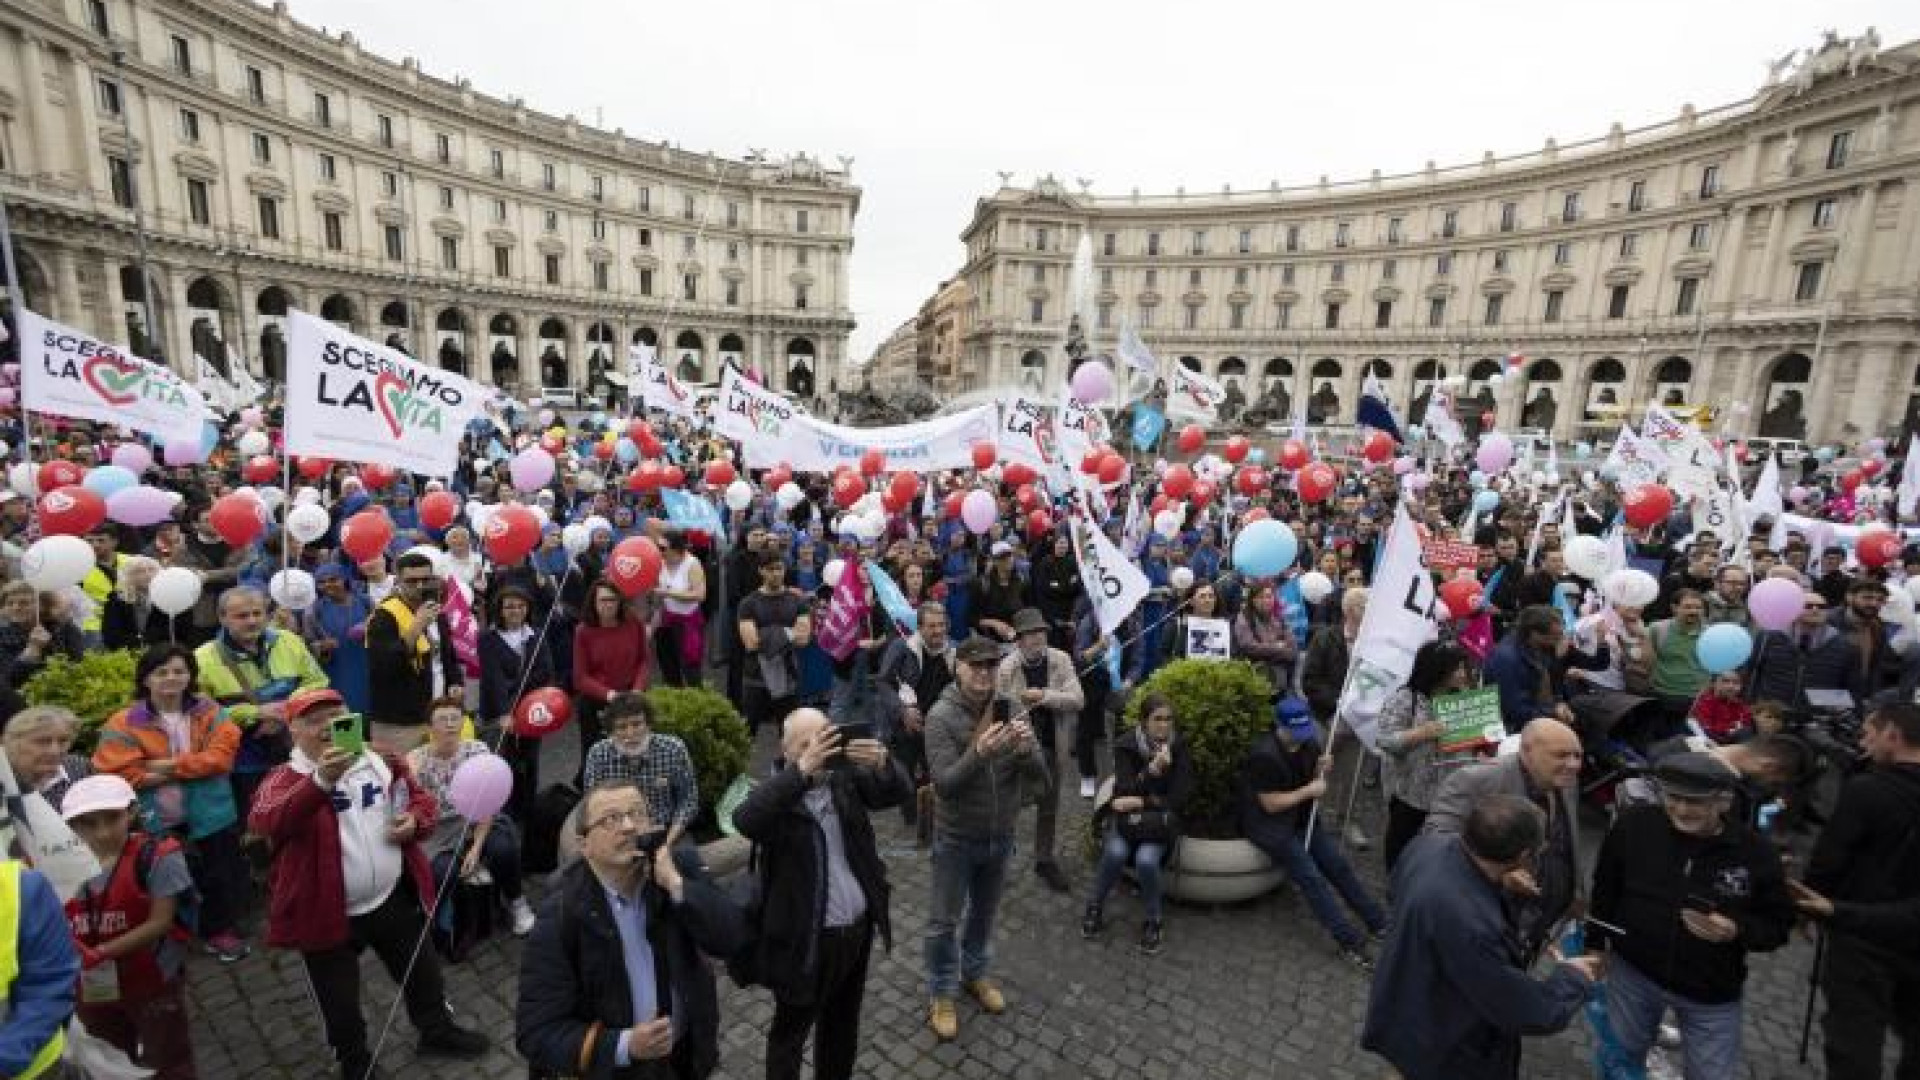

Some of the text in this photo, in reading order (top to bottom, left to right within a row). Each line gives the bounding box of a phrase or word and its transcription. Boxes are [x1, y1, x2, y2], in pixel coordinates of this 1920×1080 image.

[43, 354, 81, 380] LA
[318, 372, 374, 412] LA
[1007, 413, 1032, 437] LA
[1064, 411, 1084, 430] LA
